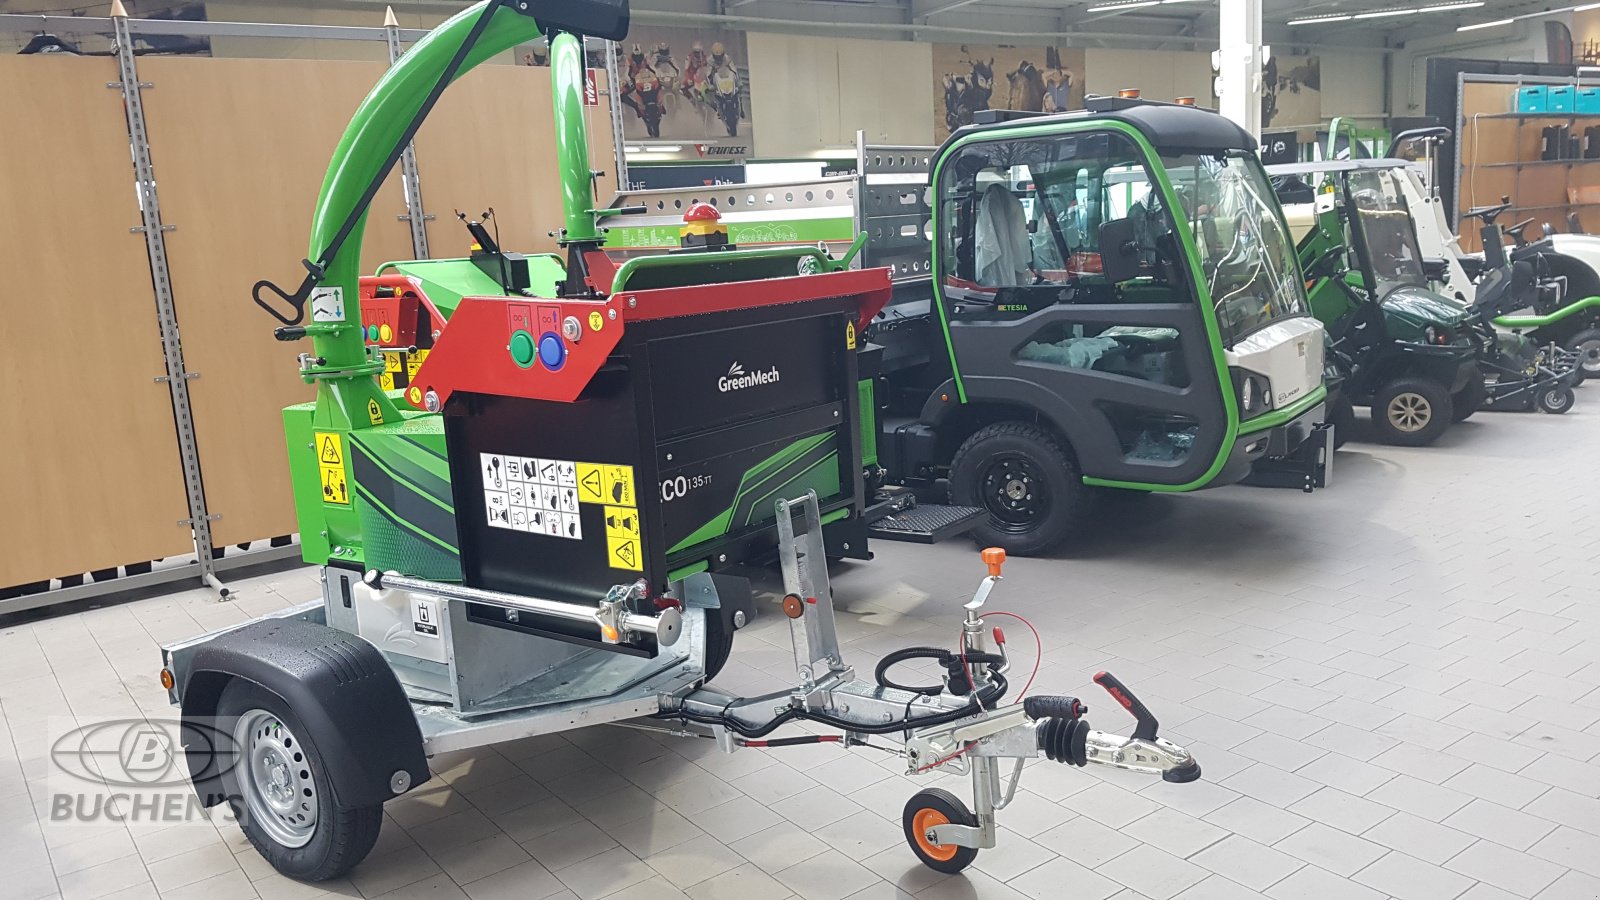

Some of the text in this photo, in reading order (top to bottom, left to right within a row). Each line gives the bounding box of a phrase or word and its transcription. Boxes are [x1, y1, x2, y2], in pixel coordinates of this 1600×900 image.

[707, 146, 747, 155] DAINESE
[718, 365, 780, 393] GreenMech
[659, 476, 687, 503] CO
